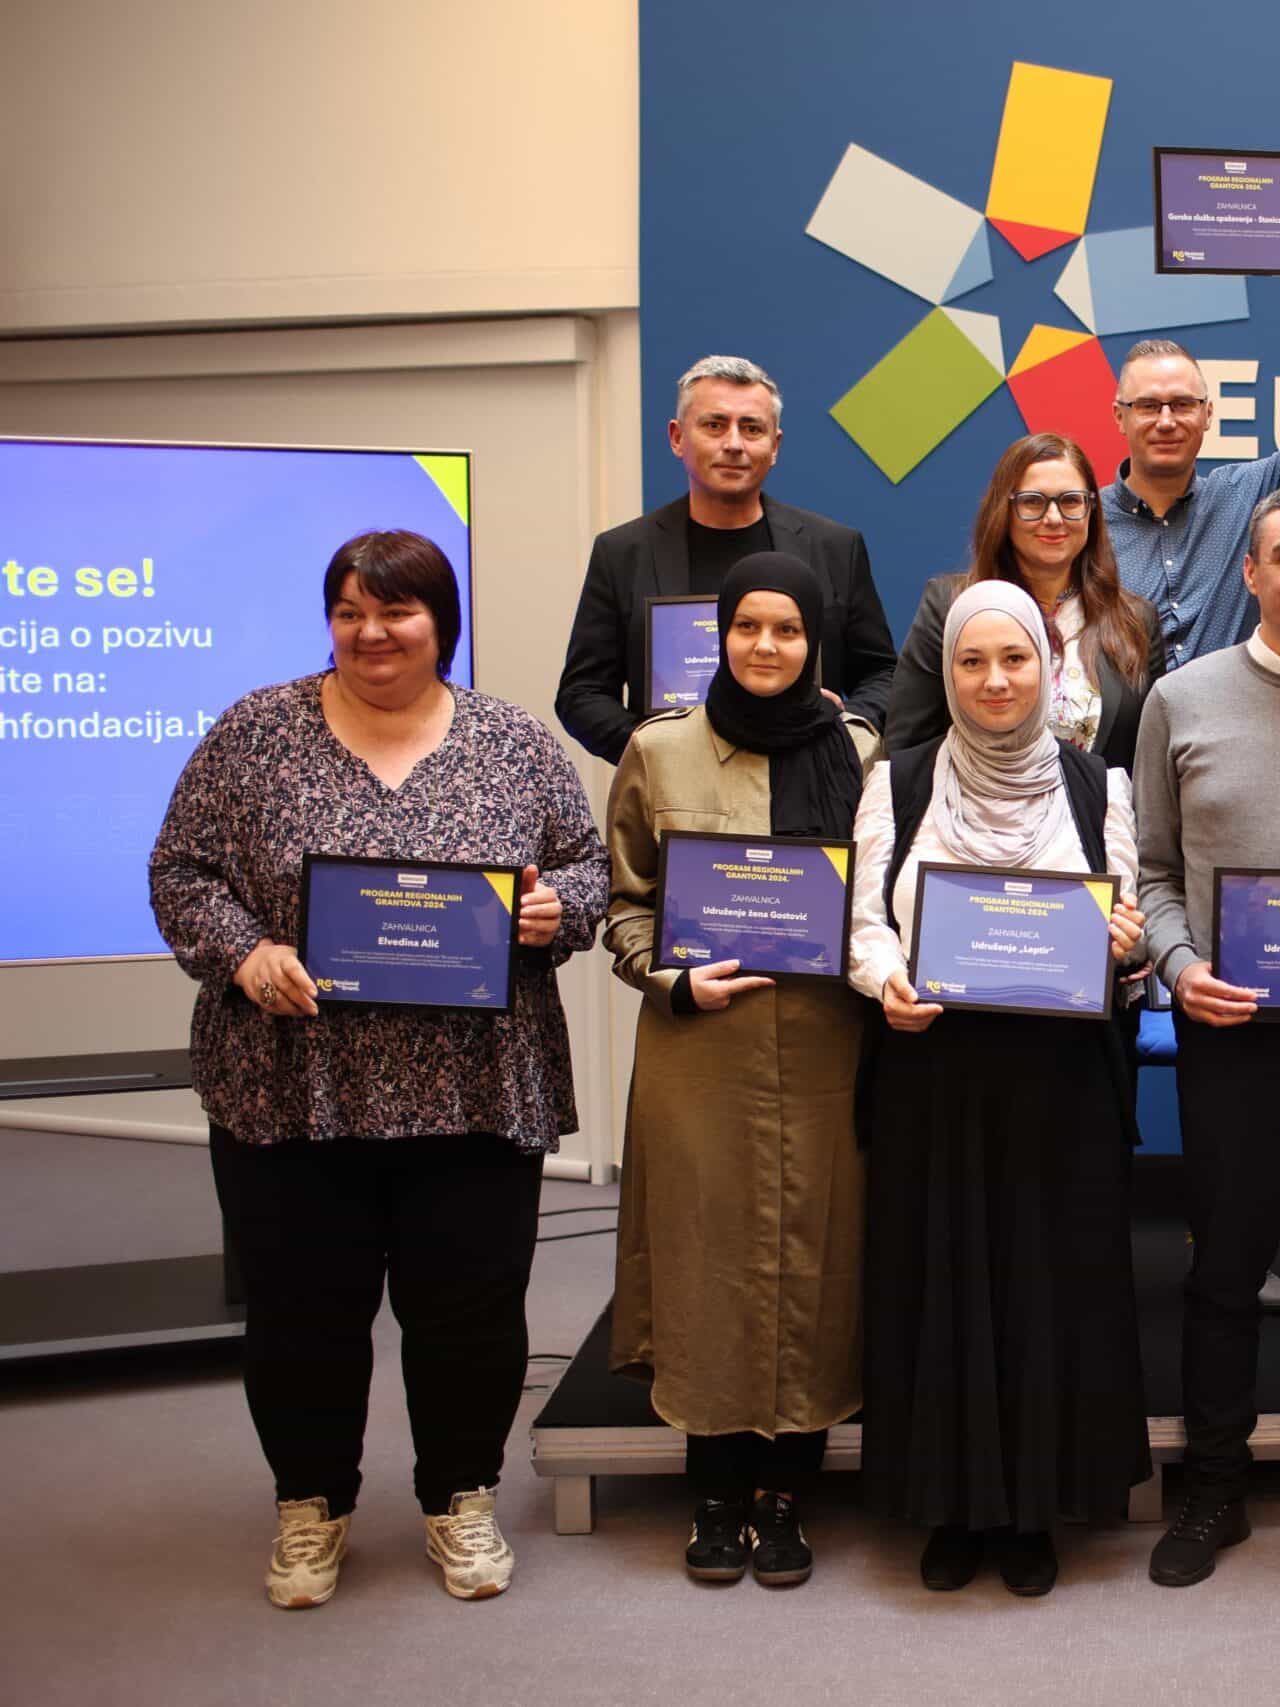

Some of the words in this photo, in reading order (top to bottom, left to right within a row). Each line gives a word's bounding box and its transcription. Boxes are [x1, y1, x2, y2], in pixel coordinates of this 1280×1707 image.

[2, 560, 58, 596] te
[75, 558, 155, 597] se!
[0, 620, 60, 654] cija
[71, 626, 91, 648] o
[103, 621, 212, 654] pozivu
[53, 672, 107, 693] na:
[360, 889, 403, 899] PROGRAM
[375, 899, 422, 908] GRANTOVA
[703, 906, 747, 919] Udruženje
[748, 909, 768, 919] žena
[770, 910, 808, 921] Gostović
[381, 922, 437, 933] ZAHVALNICA
[378, 936, 419, 948] Elvedina
[420, 938, 440, 949] Alić
[971, 940, 1017, 954] Udruženje
